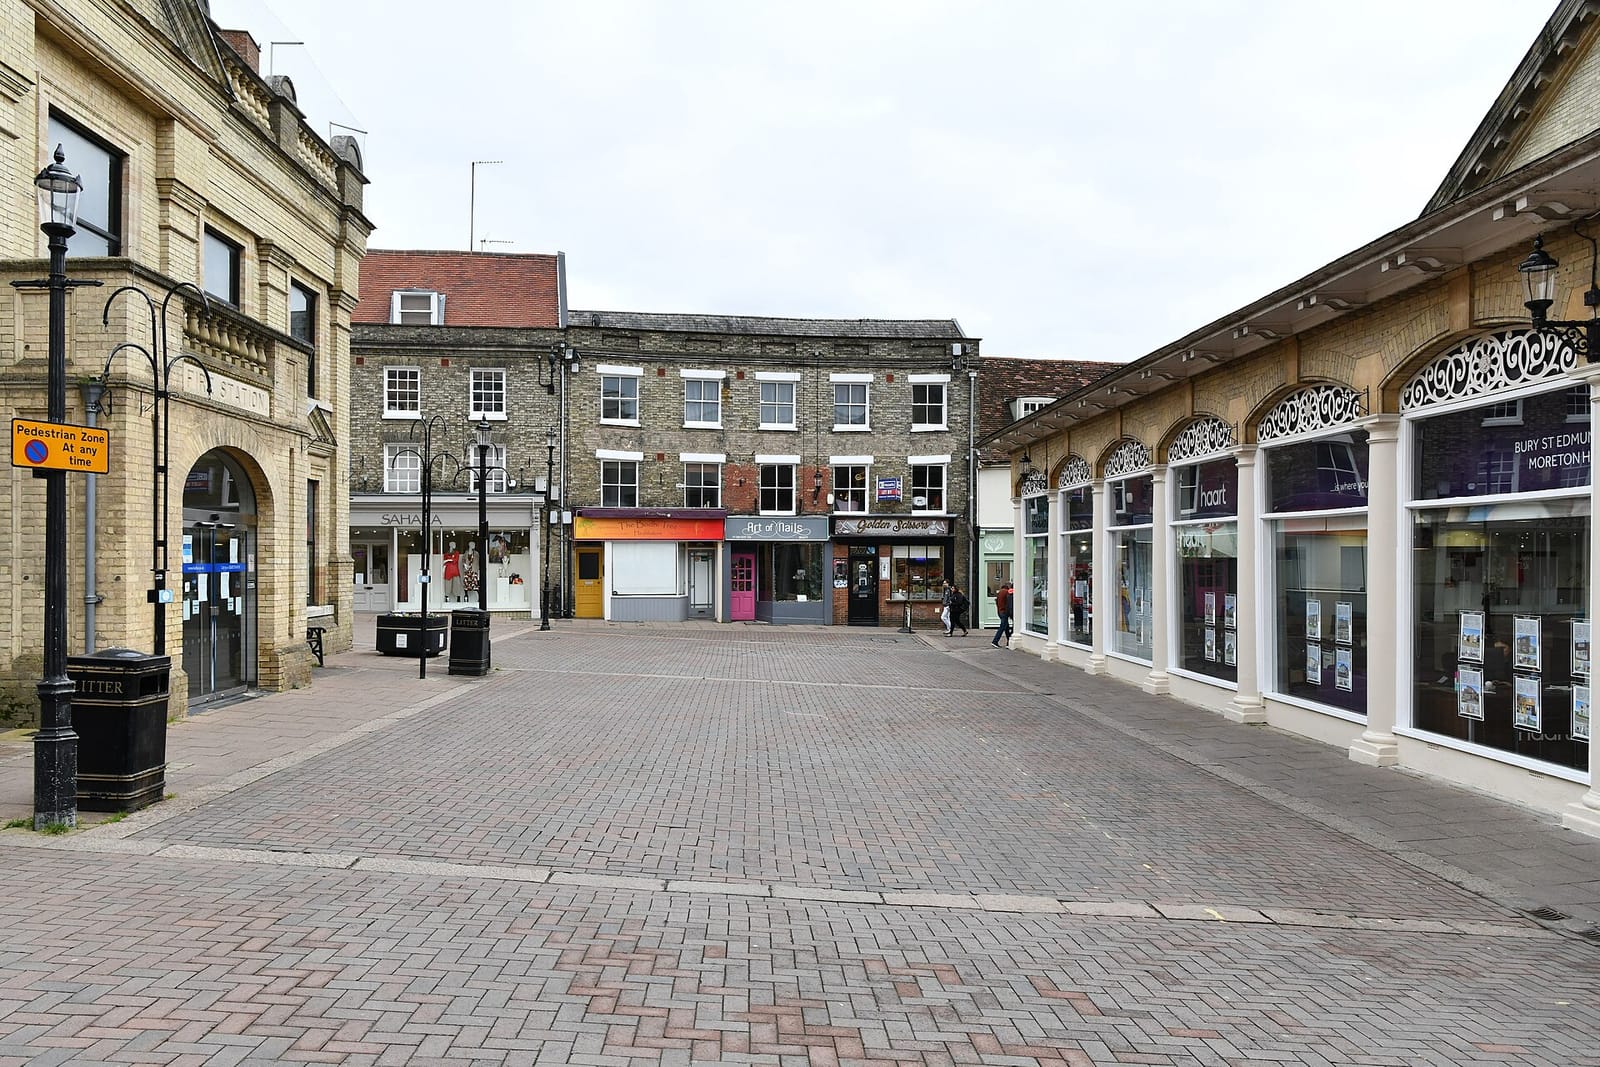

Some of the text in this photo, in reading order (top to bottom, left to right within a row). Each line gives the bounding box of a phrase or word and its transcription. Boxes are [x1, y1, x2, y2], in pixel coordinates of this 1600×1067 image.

[187, 369, 213, 395] FIR
[16, 424, 105, 444] Pedestrian Zone
[62, 442, 97, 457] At any
[1514, 438, 1540, 454] BURY
[1541, 436, 1555, 450] ST
[69, 455, 92, 467] time
[1528, 451, 1581, 470] MORETON
[1200, 482, 1227, 507] haart
[381, 513, 442, 525] SAHAA
[857, 519, 930, 534] Golden Scissors
[747, 522, 803, 533] Art of Nails
